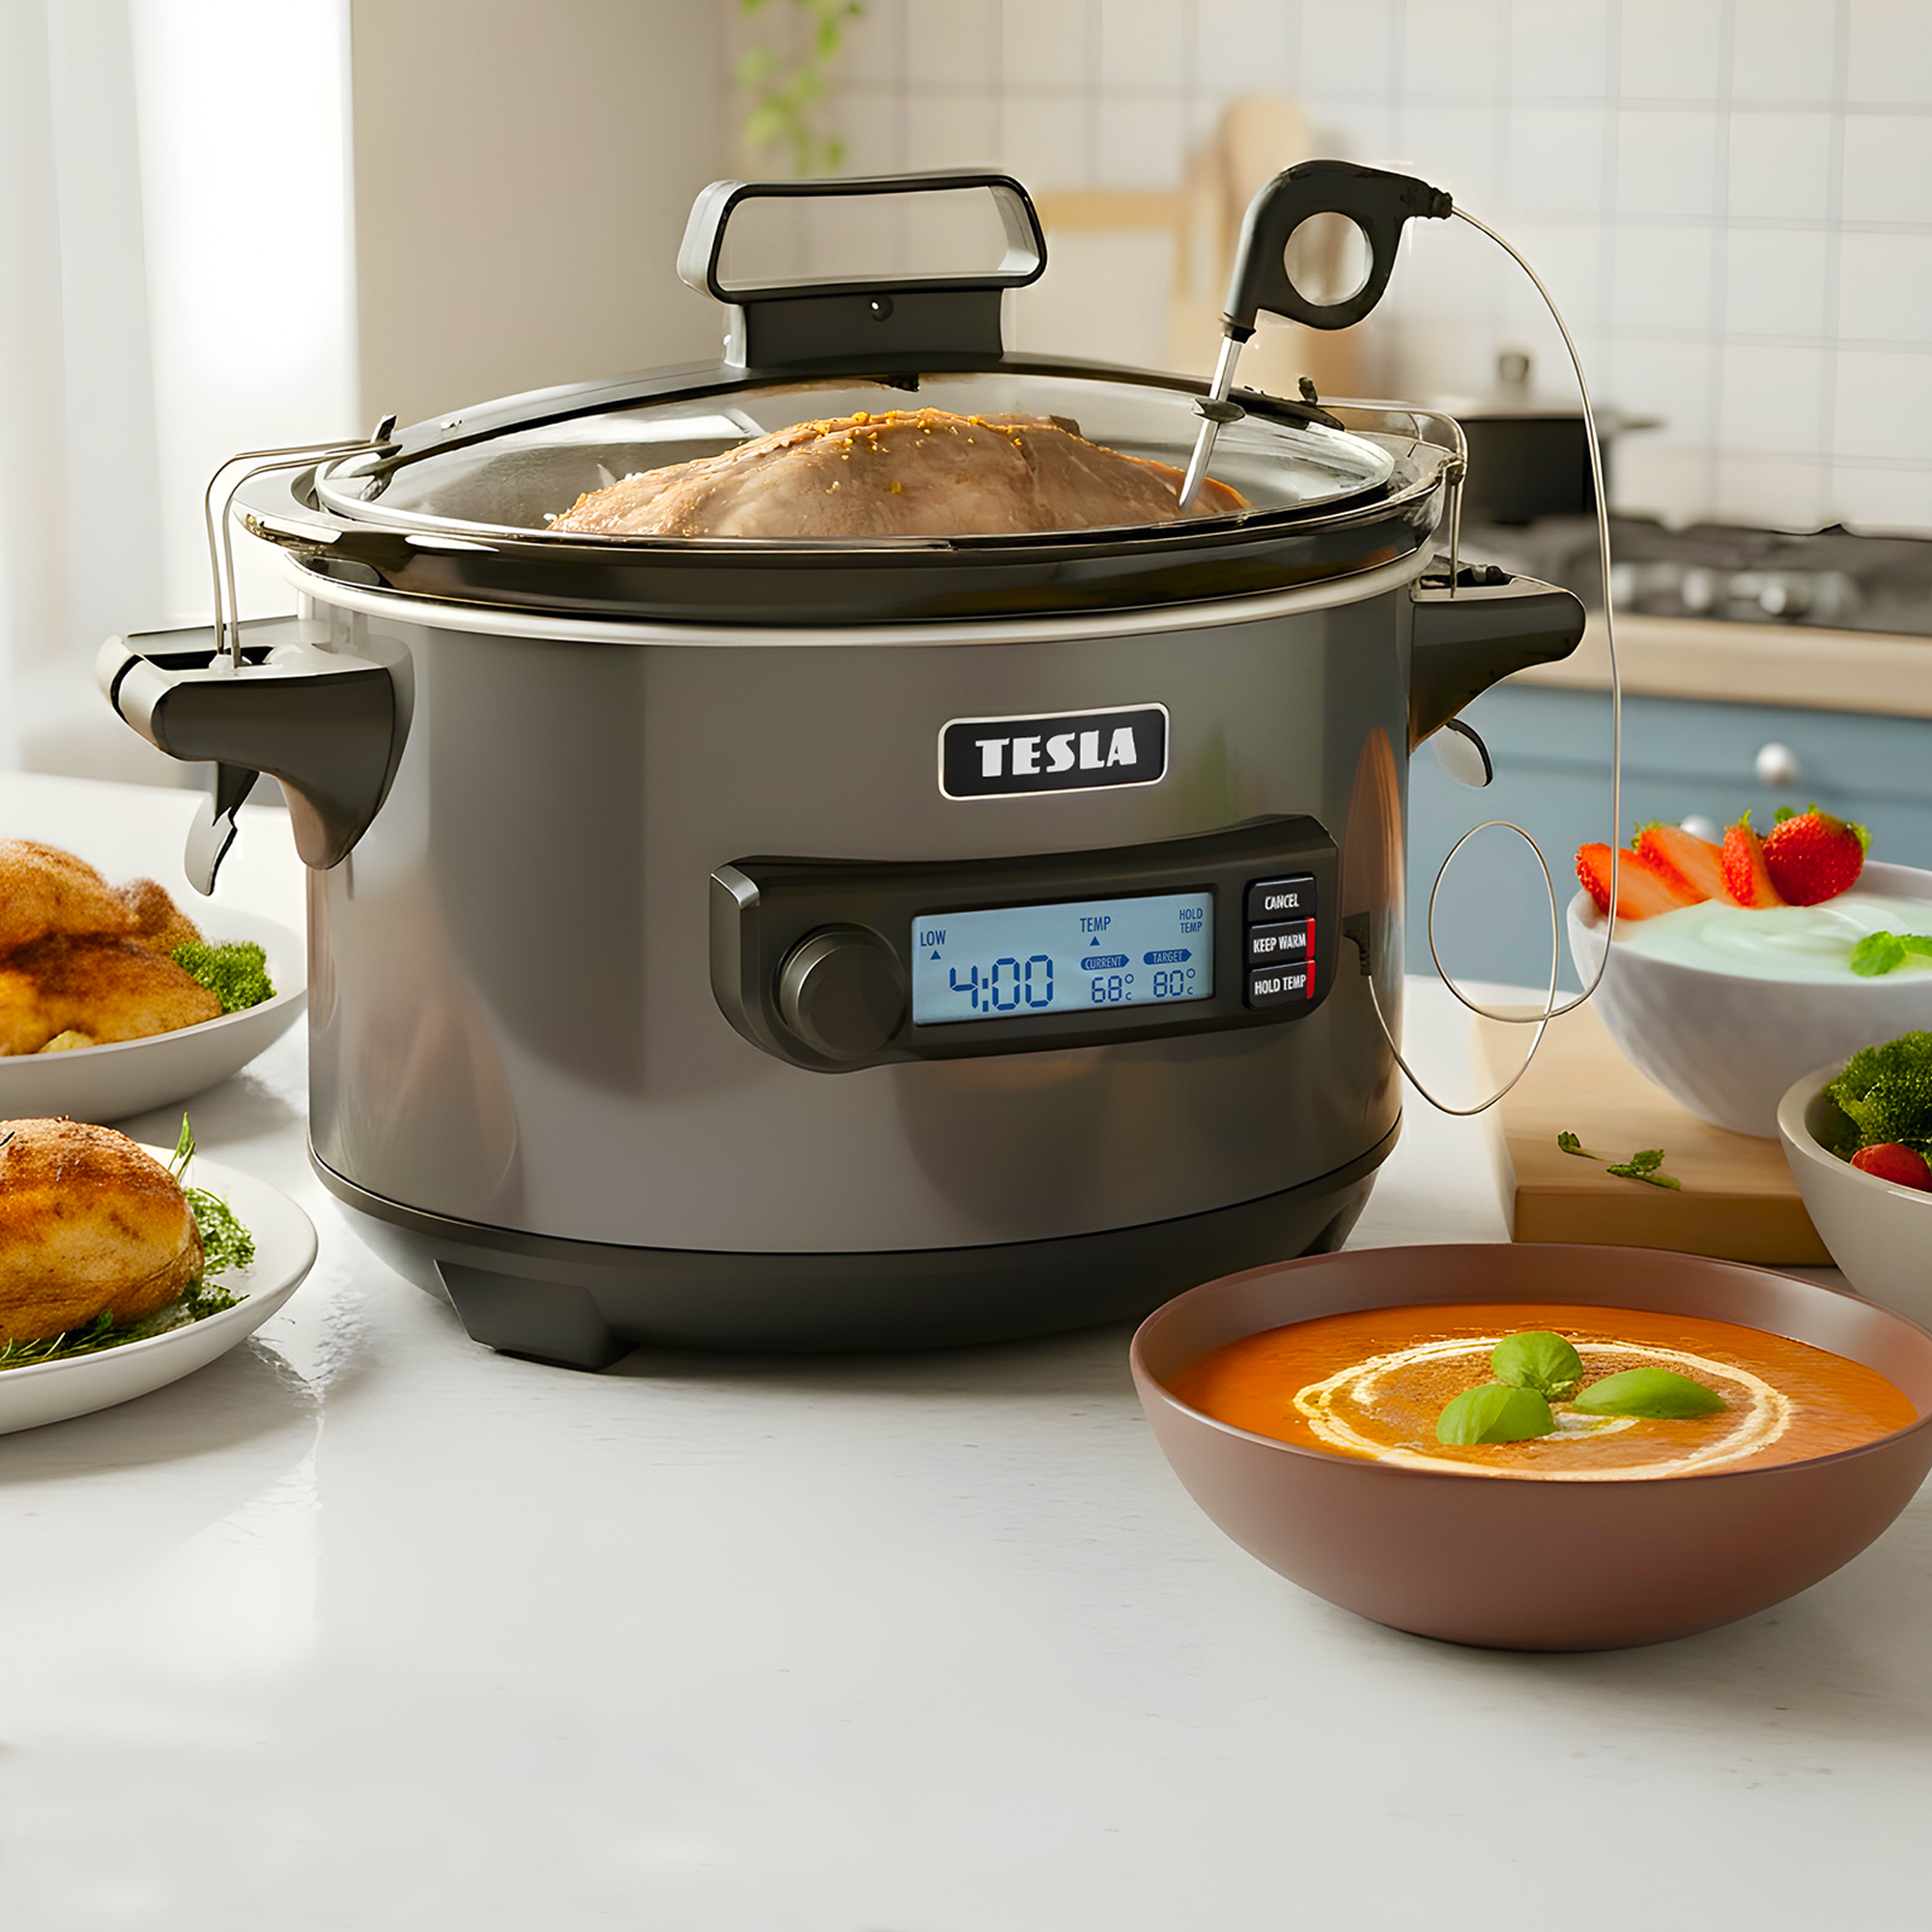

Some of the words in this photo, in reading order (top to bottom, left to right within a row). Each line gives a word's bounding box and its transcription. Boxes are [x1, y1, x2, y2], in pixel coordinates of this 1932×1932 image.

[975, 726, 1137, 778] TESLA
[1264, 893, 1300, 910] CANCEL
[1179, 908, 1204, 921] HOLD
[1080, 916, 1112, 933] TEMP
[1179, 921, 1204, 934] TEMP
[920, 929, 947, 947] LOW
[1253, 937, 1277, 953] KEEP
[1278, 933, 1307, 951] WARM
[1084, 955, 1122, 970] CURRENT
[1151, 951, 1184, 963] TARGET
[949, 954, 1054, 1012] 4:00
[1254, 978, 1281, 996] HOLD
[1282, 974, 1307, 991] TEMP
